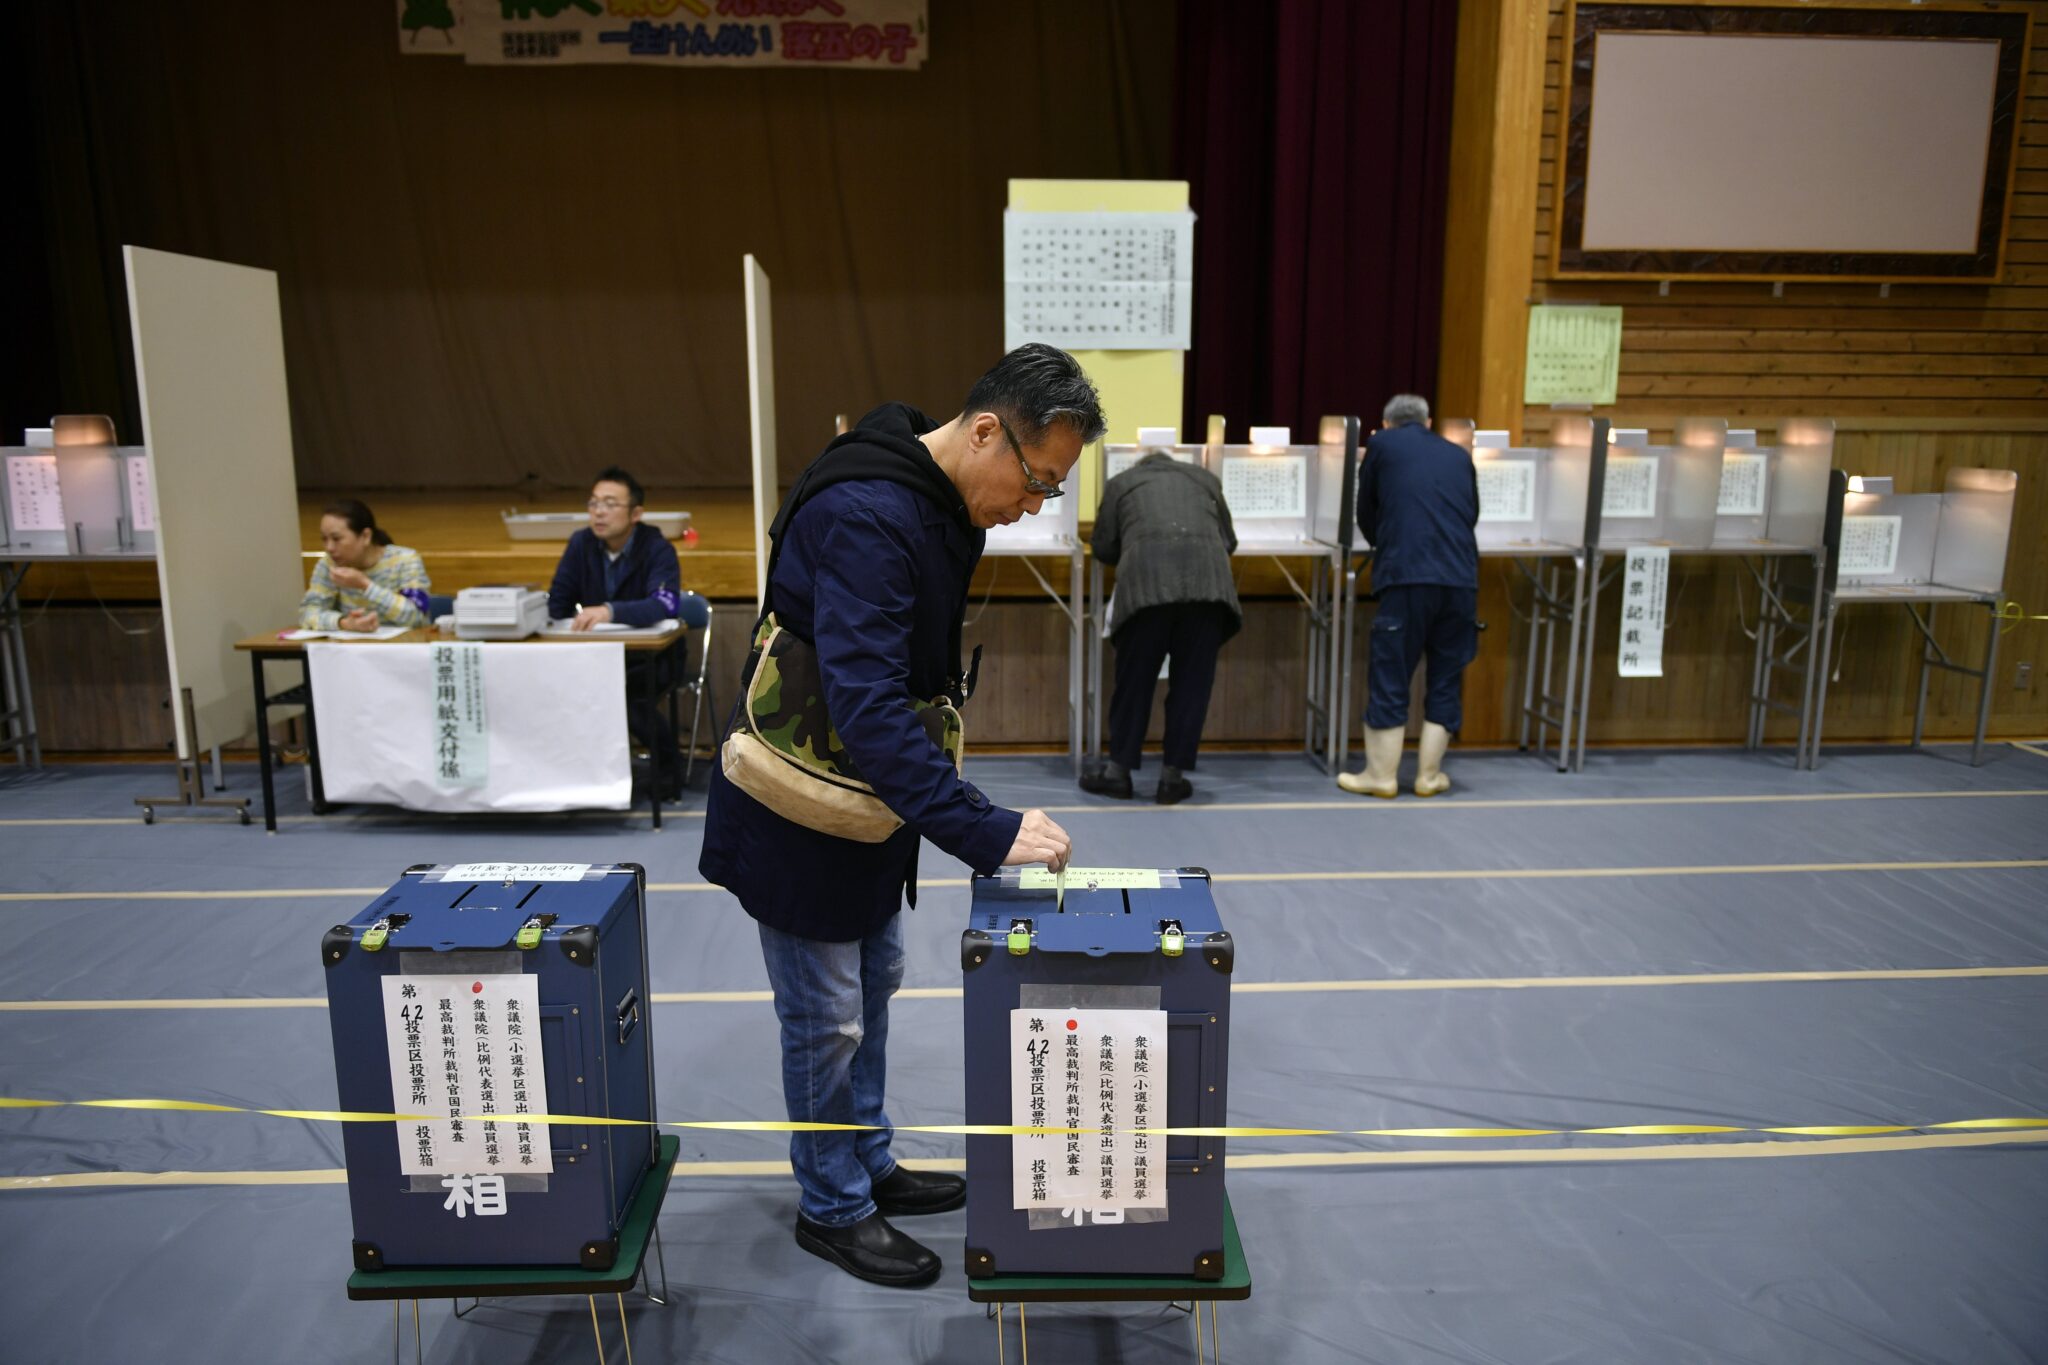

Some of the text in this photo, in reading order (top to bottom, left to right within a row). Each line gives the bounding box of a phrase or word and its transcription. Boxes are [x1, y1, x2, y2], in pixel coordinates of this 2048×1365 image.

[438, 999, 464, 1143] 最高裁判所裁判官国民審査
[473, 999, 500, 1166] 衆議院（比例代表選出議員選挙
[506, 999, 533, 1166] 衆議院（小選挙区選出議員選挙
[1066, 1034, 1081, 1176] 最高裁判所裁判官国民審査
[416, 1125, 433, 1167] 投票箱
[1030, 1159, 1047, 1201] 投票箱
